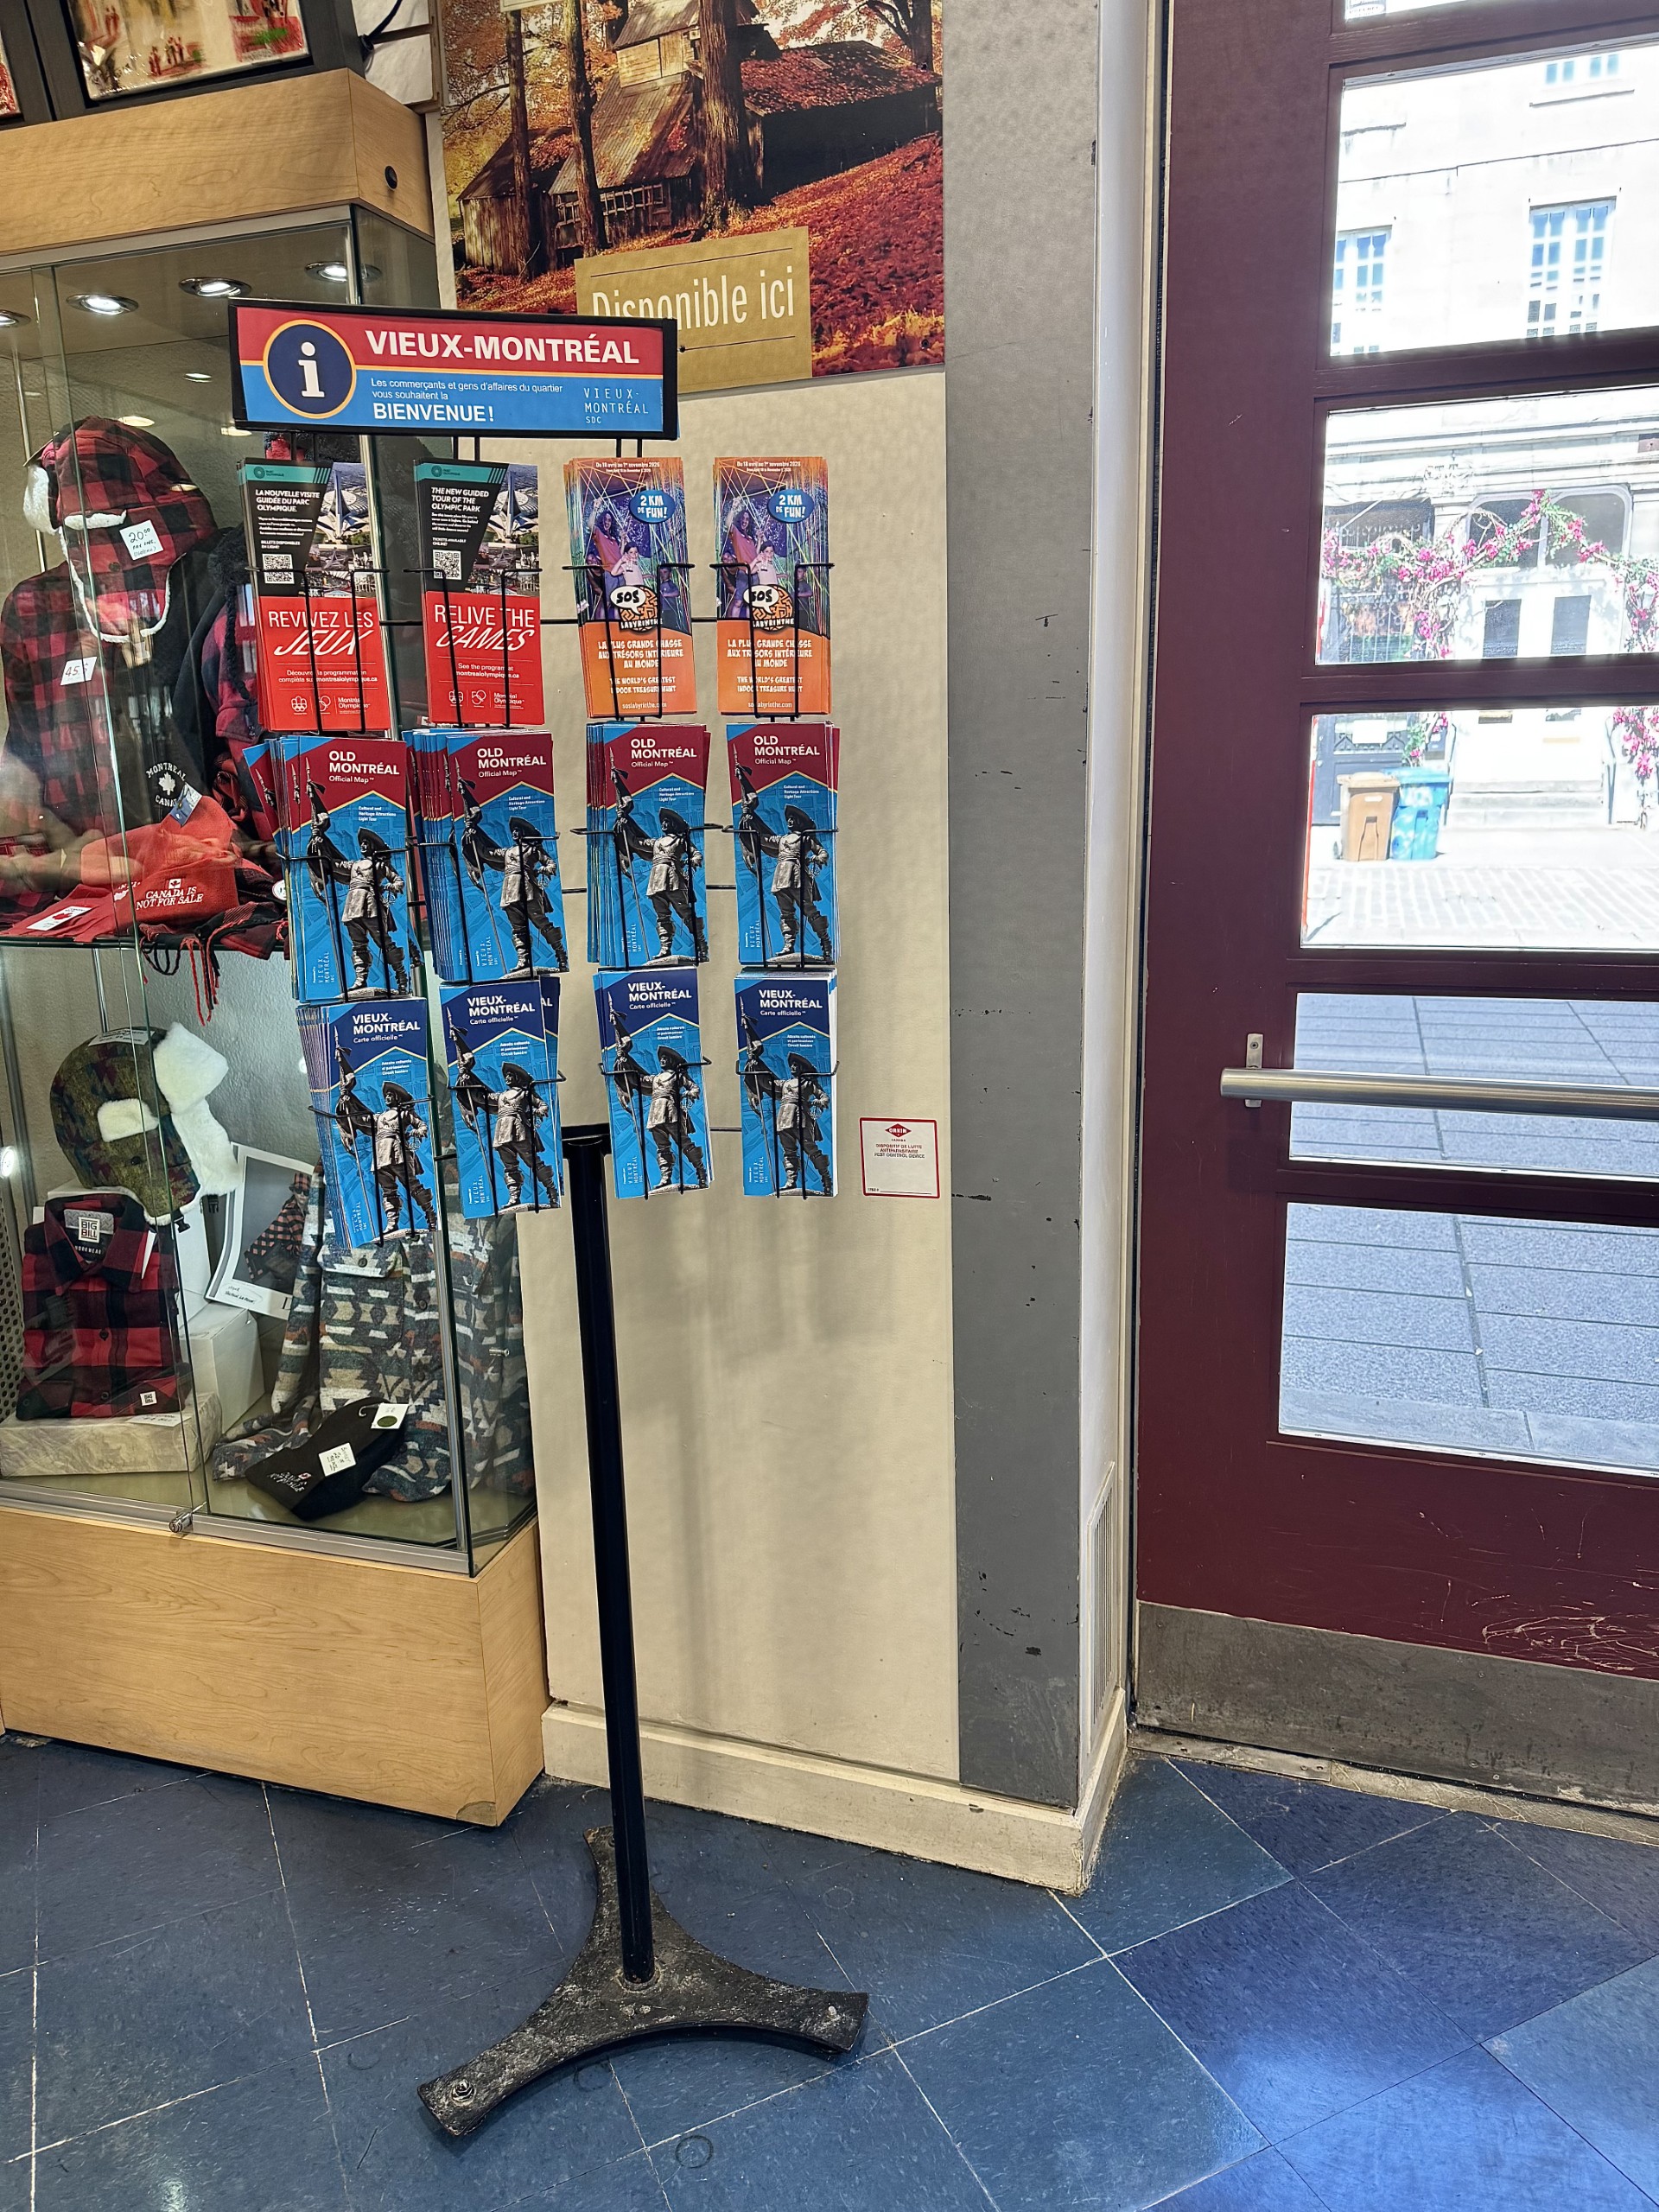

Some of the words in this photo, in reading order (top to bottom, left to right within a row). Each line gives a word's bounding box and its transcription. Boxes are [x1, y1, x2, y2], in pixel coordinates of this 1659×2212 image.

[760, 265, 793, 320] ici
[365, 330, 639, 364] VIEUX-MONTRÉAL
[371, 378, 387, 388] Les
[389, 379, 446, 392] commerçants
[448, 382, 456, 391] et
[458, 384, 479, 394] gens
[480, 382, 518, 393] d'affaires
[520, 383, 531, 393] du
[531, 384, 563, 395] quartier
[395, 391, 435, 400] souhaitent
[437, 391, 448, 400] la
[584, 399, 649, 415] MONTRÉAL
[586, 416, 601, 424] SDC
[640, 496, 647, 506] 2
[649, 495, 664, 506] KM
[779, 495, 786, 505] 2
[787, 495, 802, 505] KM
[645, 506, 668, 518] FUN!
[784, 506, 805, 518] FUN!
[616, 589, 639, 604] SOS
[268, 611, 340, 628] REVIVEZ
[344, 611, 374, 628] LES
[435, 605, 496, 626] RELIVE
[753, 618, 794, 628] LABYRINTHE
[274, 629, 374, 656] JEUX
[435, 626, 535, 652] GAMES
[610, 640, 626, 649] LUS
[627, 639, 654, 649] GRANDE
[757, 639, 784, 648] GRANDE
[613, 649, 644, 658] TRÉSORS
[645, 649, 683, 658] INTRIEURE
[727, 649, 741, 658] AUX
[742, 649, 773, 658] TRSORS
[774, 649, 812, 658] INTÉREURE
[624, 660, 633, 669] AU
[635, 659, 659, 669] MONDE
[455, 671, 519, 679] montrealolympiqe.ca
[622, 702, 667, 710] soslabyrinthe.cm
[631, 739, 656, 748] OLD
[753, 735, 779, 746] OLD
[477, 747, 503, 759] OLD
[631, 747, 697, 759] MONTRÉAL
[754, 744, 820, 756] MONTRÉAL
[329, 751, 356, 762] OLD
[478, 754, 546, 769] MONTRÉAL
[146, 762, 186, 782] MONTREAL
[329, 762, 400, 775] MONTRÉAL
[155, 795, 177, 807] CANA
[145, 887, 187, 899] CANADA
[187, 886, 197, 895] IS
[136, 899, 157, 911] NOT
[158, 897, 176, 907] FOR
[177, 893, 204, 904] SALE
[628, 982, 665, 992] VIEUX-
[629, 988, 692, 1002] MONTRÉAL
[759, 990, 796, 999] VIEUX-
[467, 995, 507, 1007] VIEUX-
[760, 998, 823, 1008] MONTRÉAL
[469, 1002, 535, 1017] MONTRÉAL
[353, 1013, 392, 1024] VIEUX-
[353, 1020, 421, 1035] MONTRÉAL
[81, 1221, 98, 1230] BIG
[81, 1230, 98, 1238] BILL
